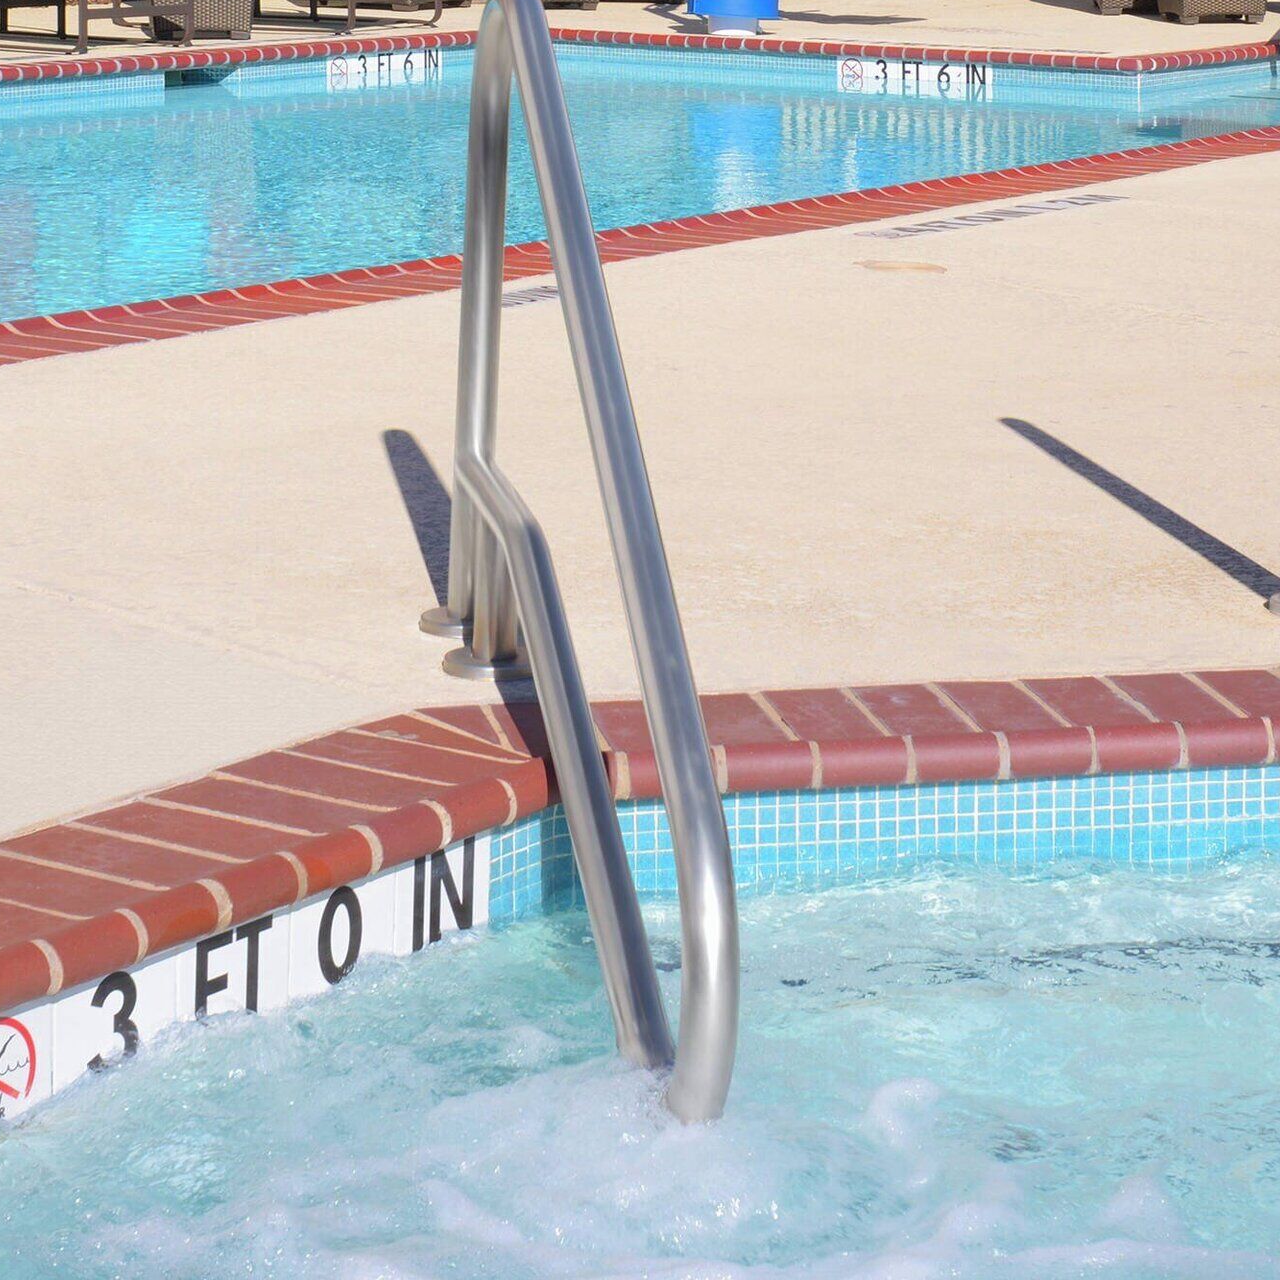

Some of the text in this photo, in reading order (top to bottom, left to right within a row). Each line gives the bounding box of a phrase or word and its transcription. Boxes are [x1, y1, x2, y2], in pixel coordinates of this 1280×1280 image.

[357, 49, 438, 73] 3 FT 6 IN
[875, 59, 986, 84] 3 FT 6 IN
[87, 970, 139, 1074] 3
[194, 914, 274, 1022] FT
[412, 835, 475, 953] IN
